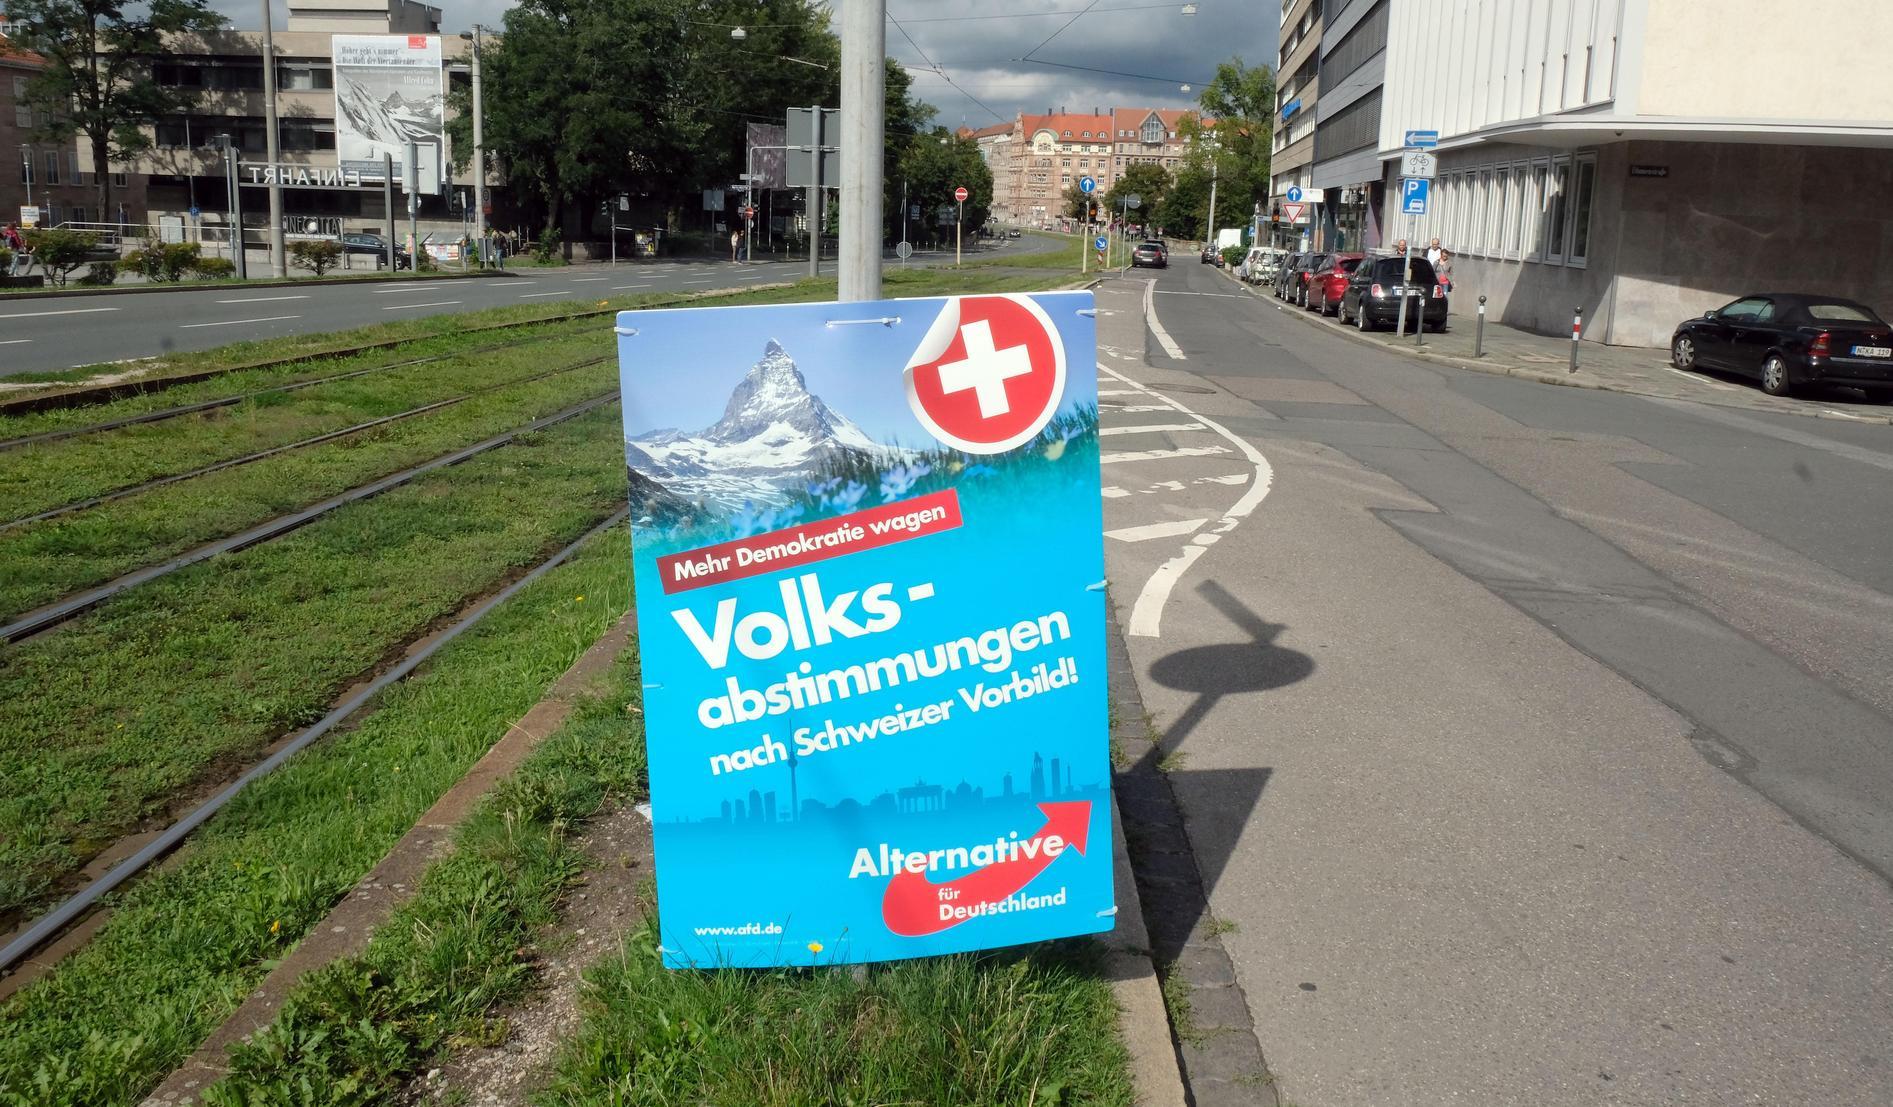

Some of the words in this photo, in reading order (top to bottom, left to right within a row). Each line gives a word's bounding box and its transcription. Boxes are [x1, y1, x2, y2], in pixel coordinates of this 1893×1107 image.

[1407, 181, 1419, 196] P
[673, 553, 732, 581] Mehr
[735, 523, 865, 567] Demokratie
[868, 506, 946, 536] wagen
[697, 609, 1071, 729] abstimmungen
[709, 734, 788, 776] nach
[793, 703, 955, 757] Schweizer
[958, 656, 1079, 713] Vorbild!
[848, 830, 1064, 879] Alternative
[937, 887, 961, 901] für
[938, 886, 1067, 921] Deutschland
[694, 922, 783, 936] www.afd.de
